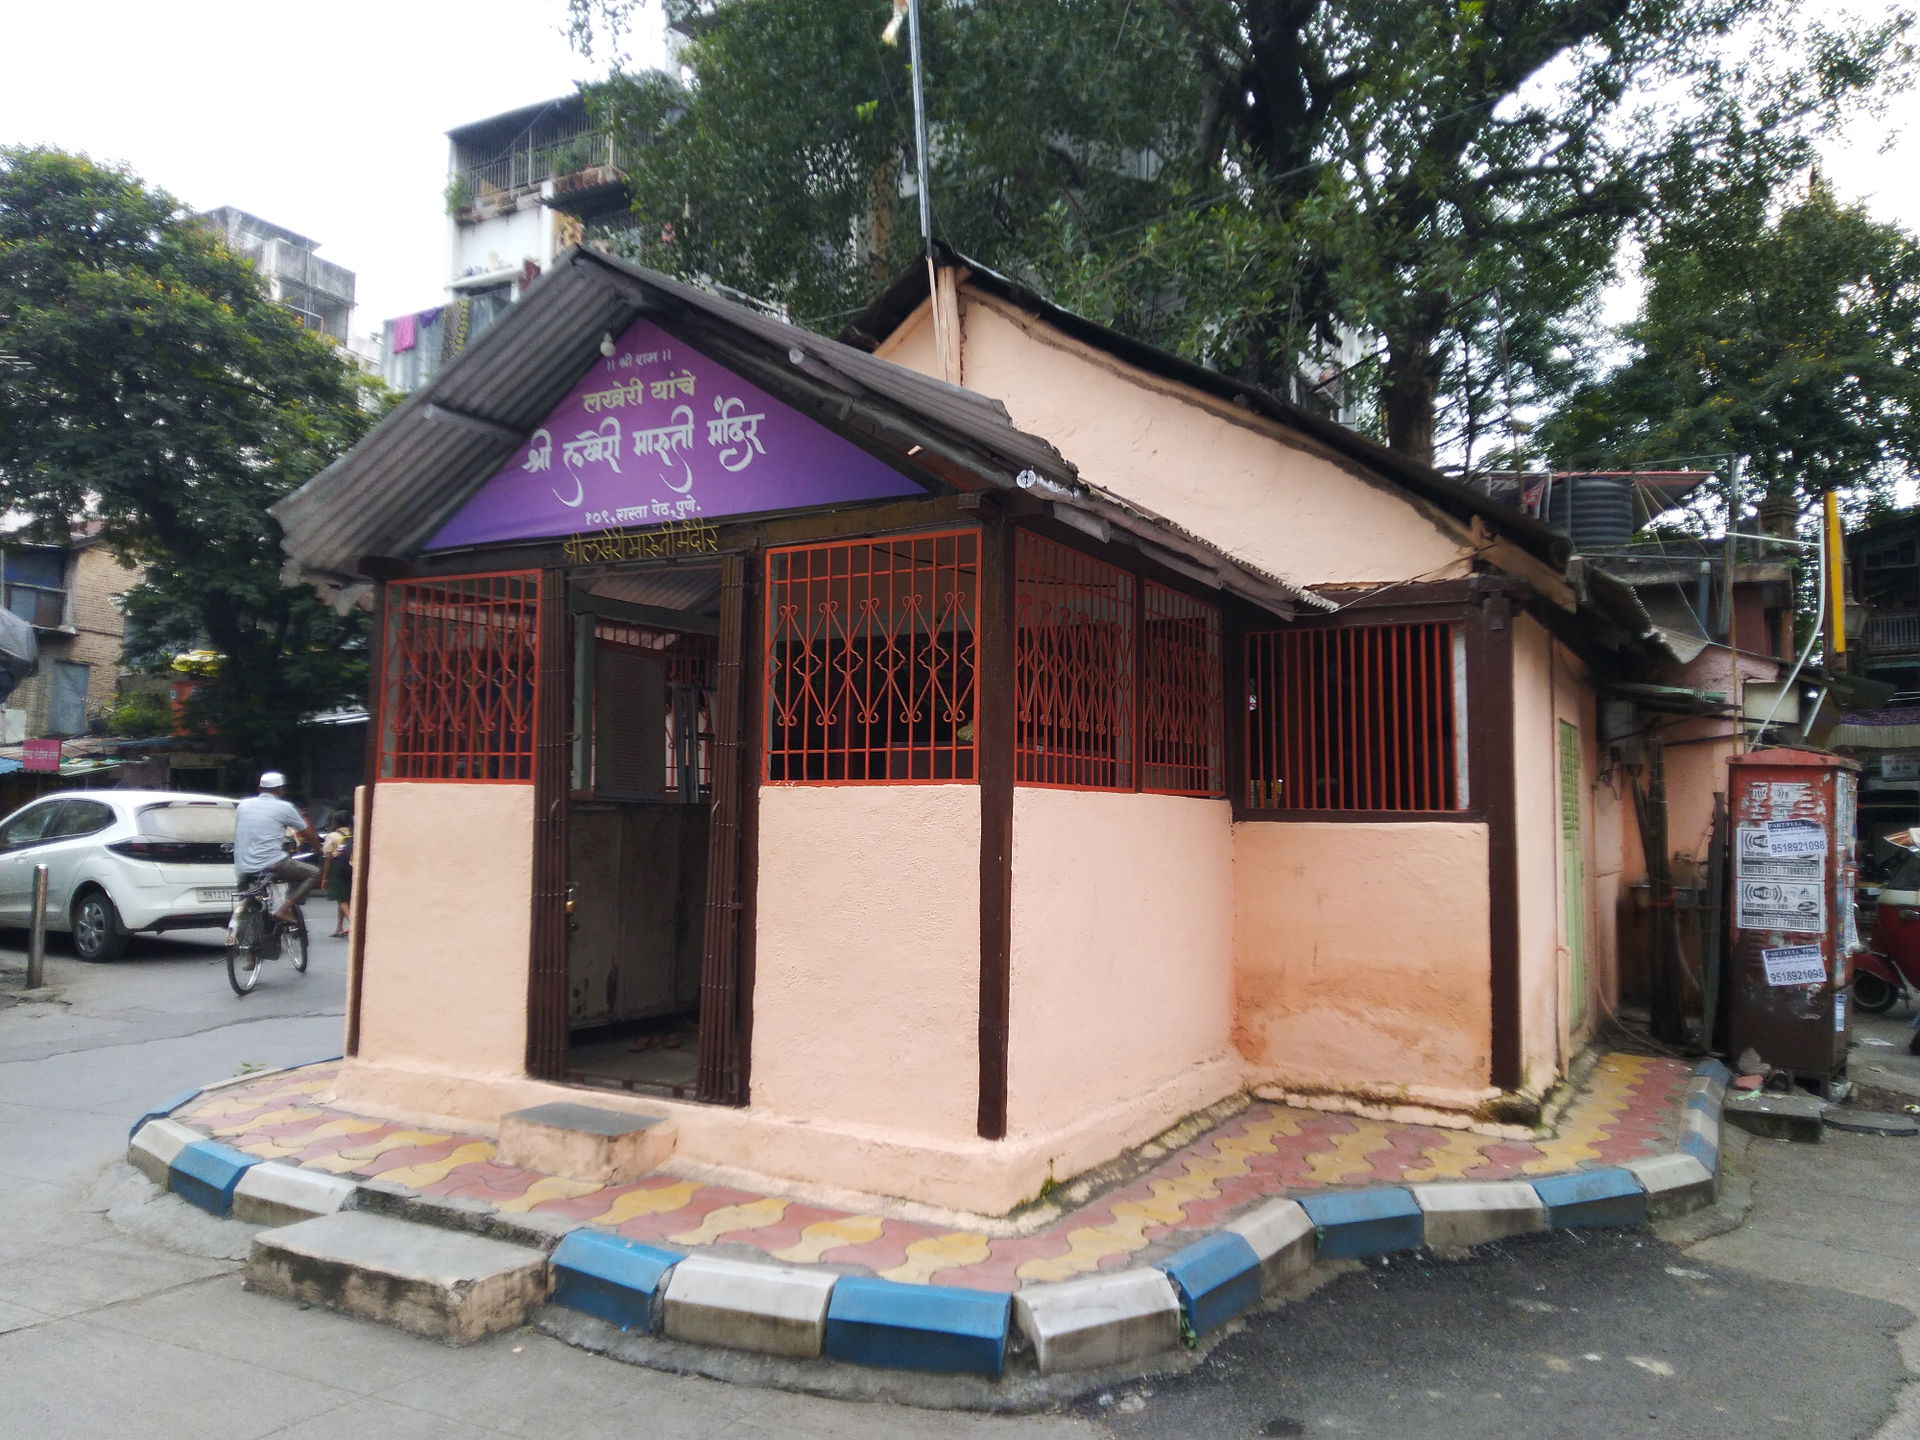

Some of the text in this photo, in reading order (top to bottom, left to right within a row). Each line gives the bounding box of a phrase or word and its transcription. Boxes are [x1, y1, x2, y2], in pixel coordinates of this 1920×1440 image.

[582, 369, 697, 414] लखेरी यांचे
[521, 428, 553, 474] श्री
[552, 416, 623, 507] लखेरी
[706, 395, 767, 472] मंदिर
[1771, 840, 1825, 853] 9518921098
[1770, 968, 1824, 982] 9518921098
